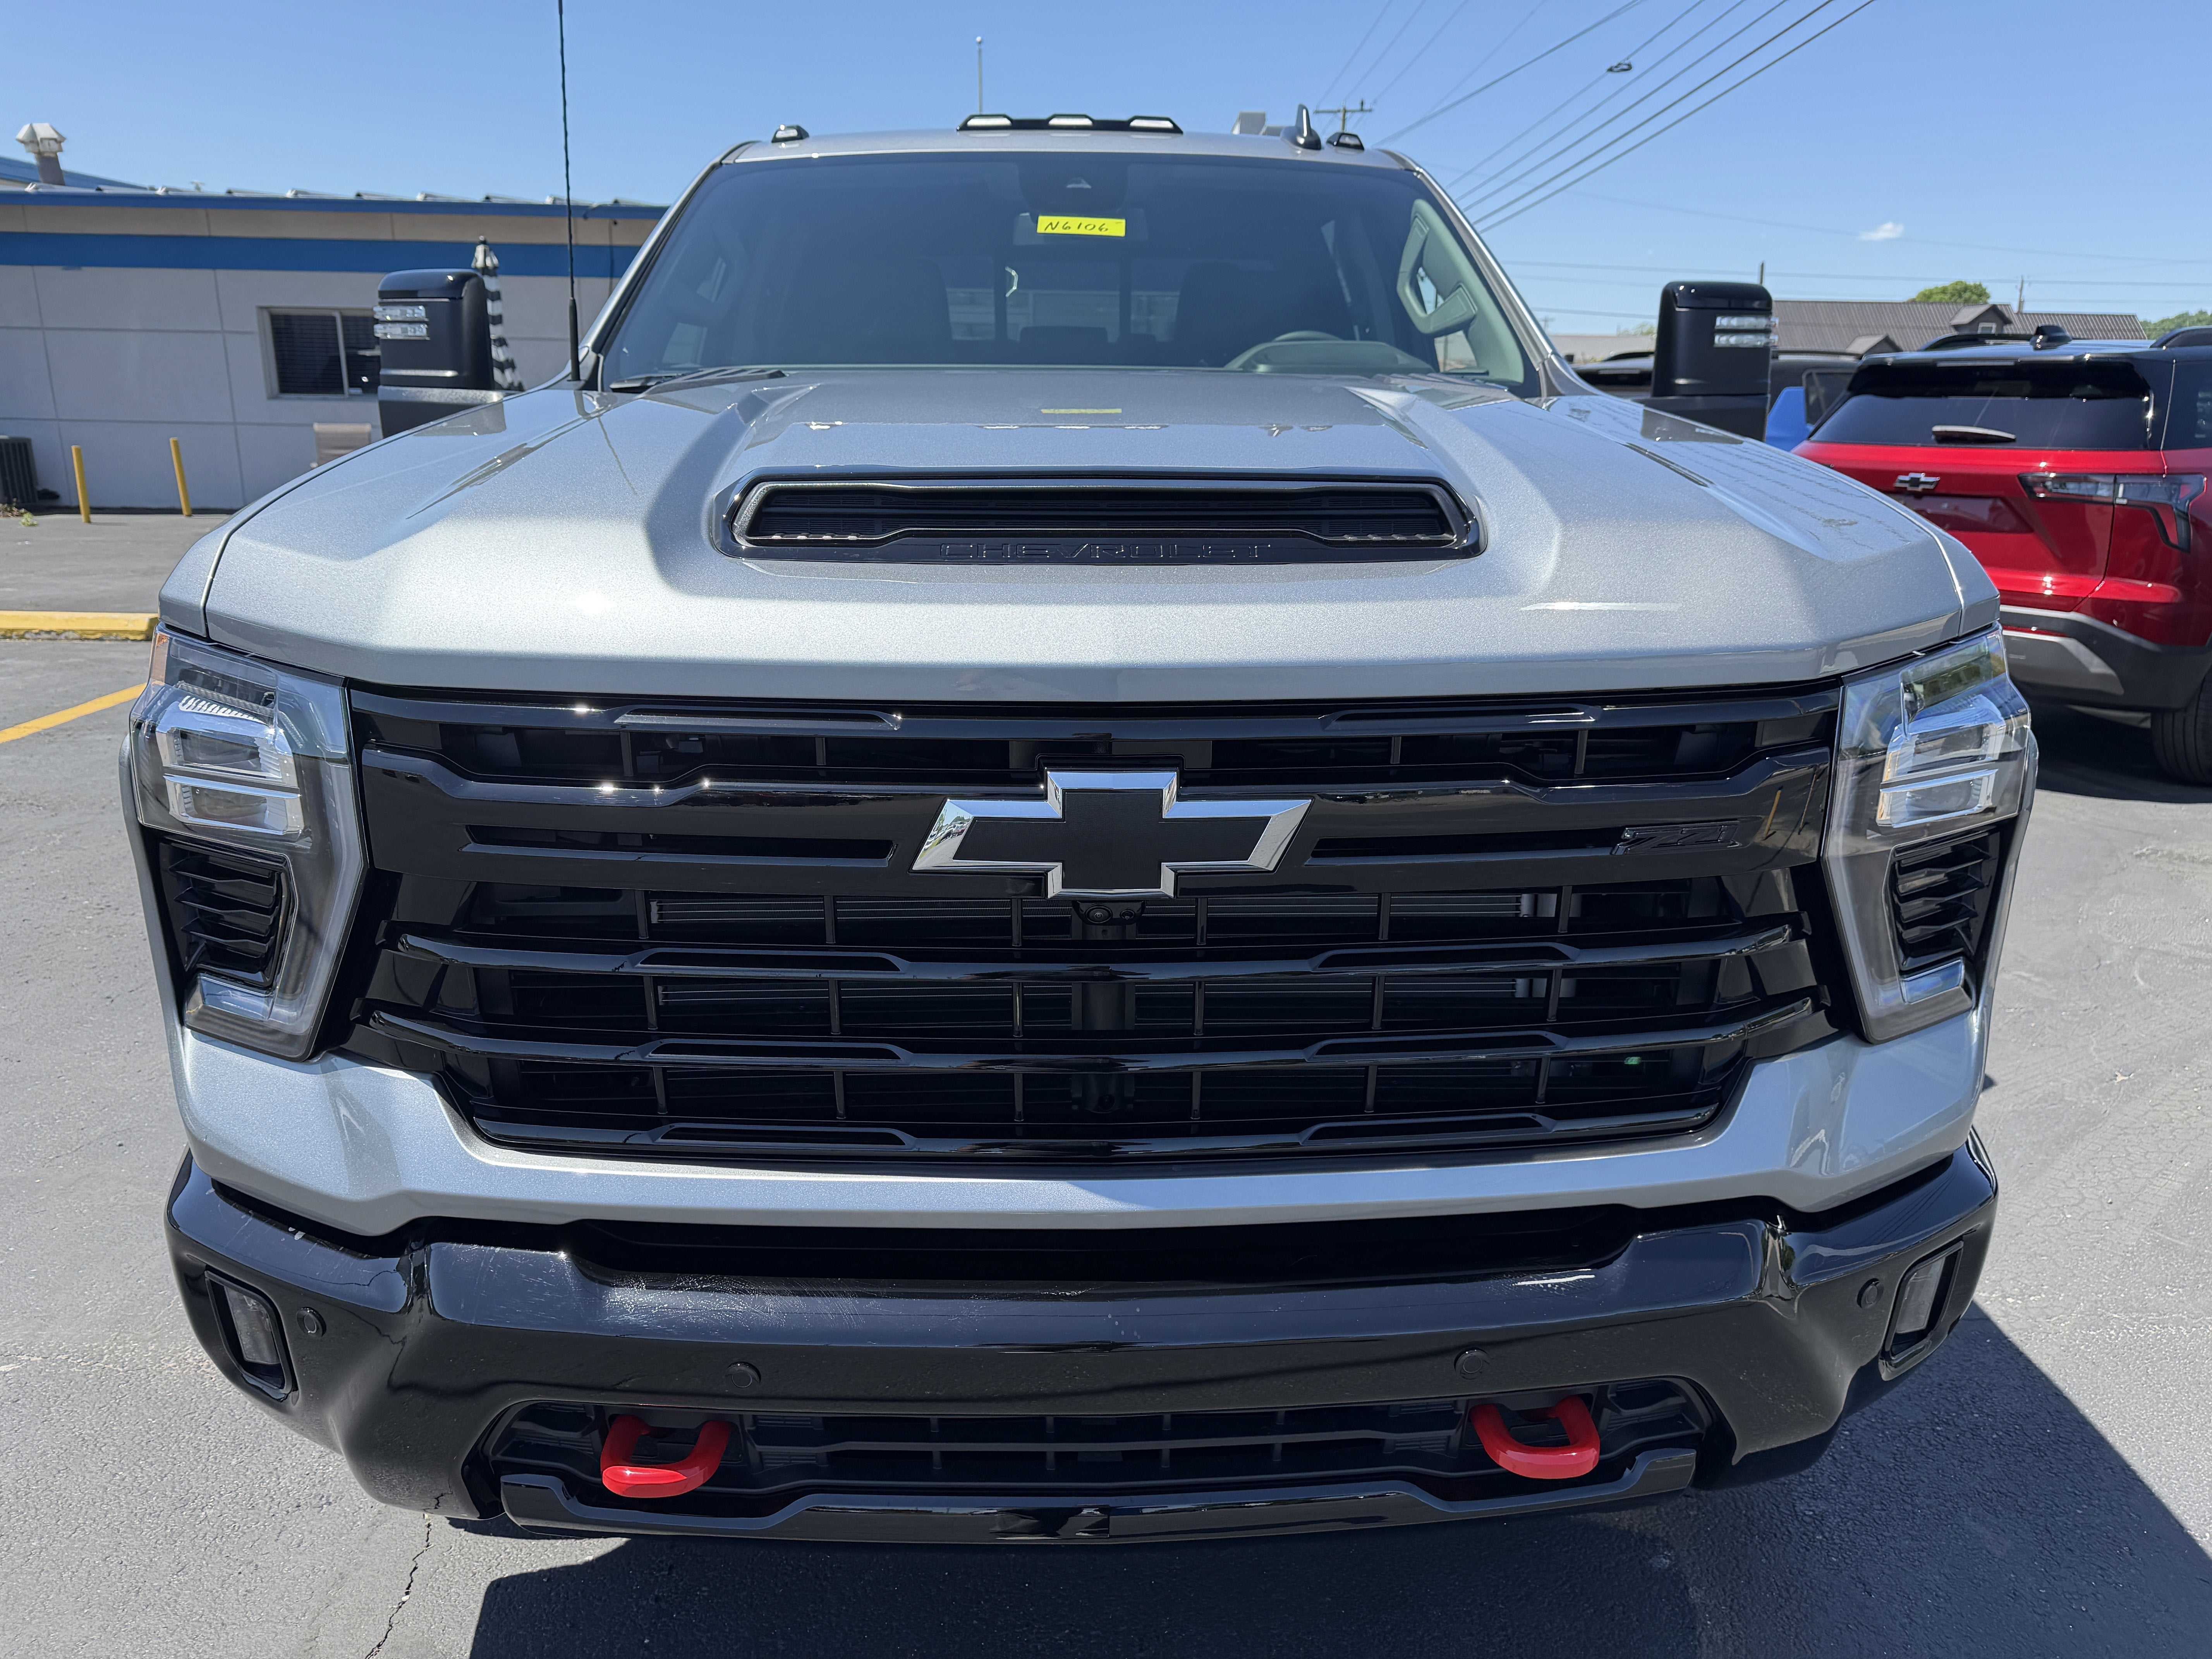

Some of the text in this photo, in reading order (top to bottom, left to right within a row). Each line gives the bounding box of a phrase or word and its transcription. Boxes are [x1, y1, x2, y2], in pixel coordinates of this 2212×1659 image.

[1044, 221, 1108, 232] N6106
[940, 543, 1271, 558] CHEVROLET
[1611, 820, 1742, 855] Z71
